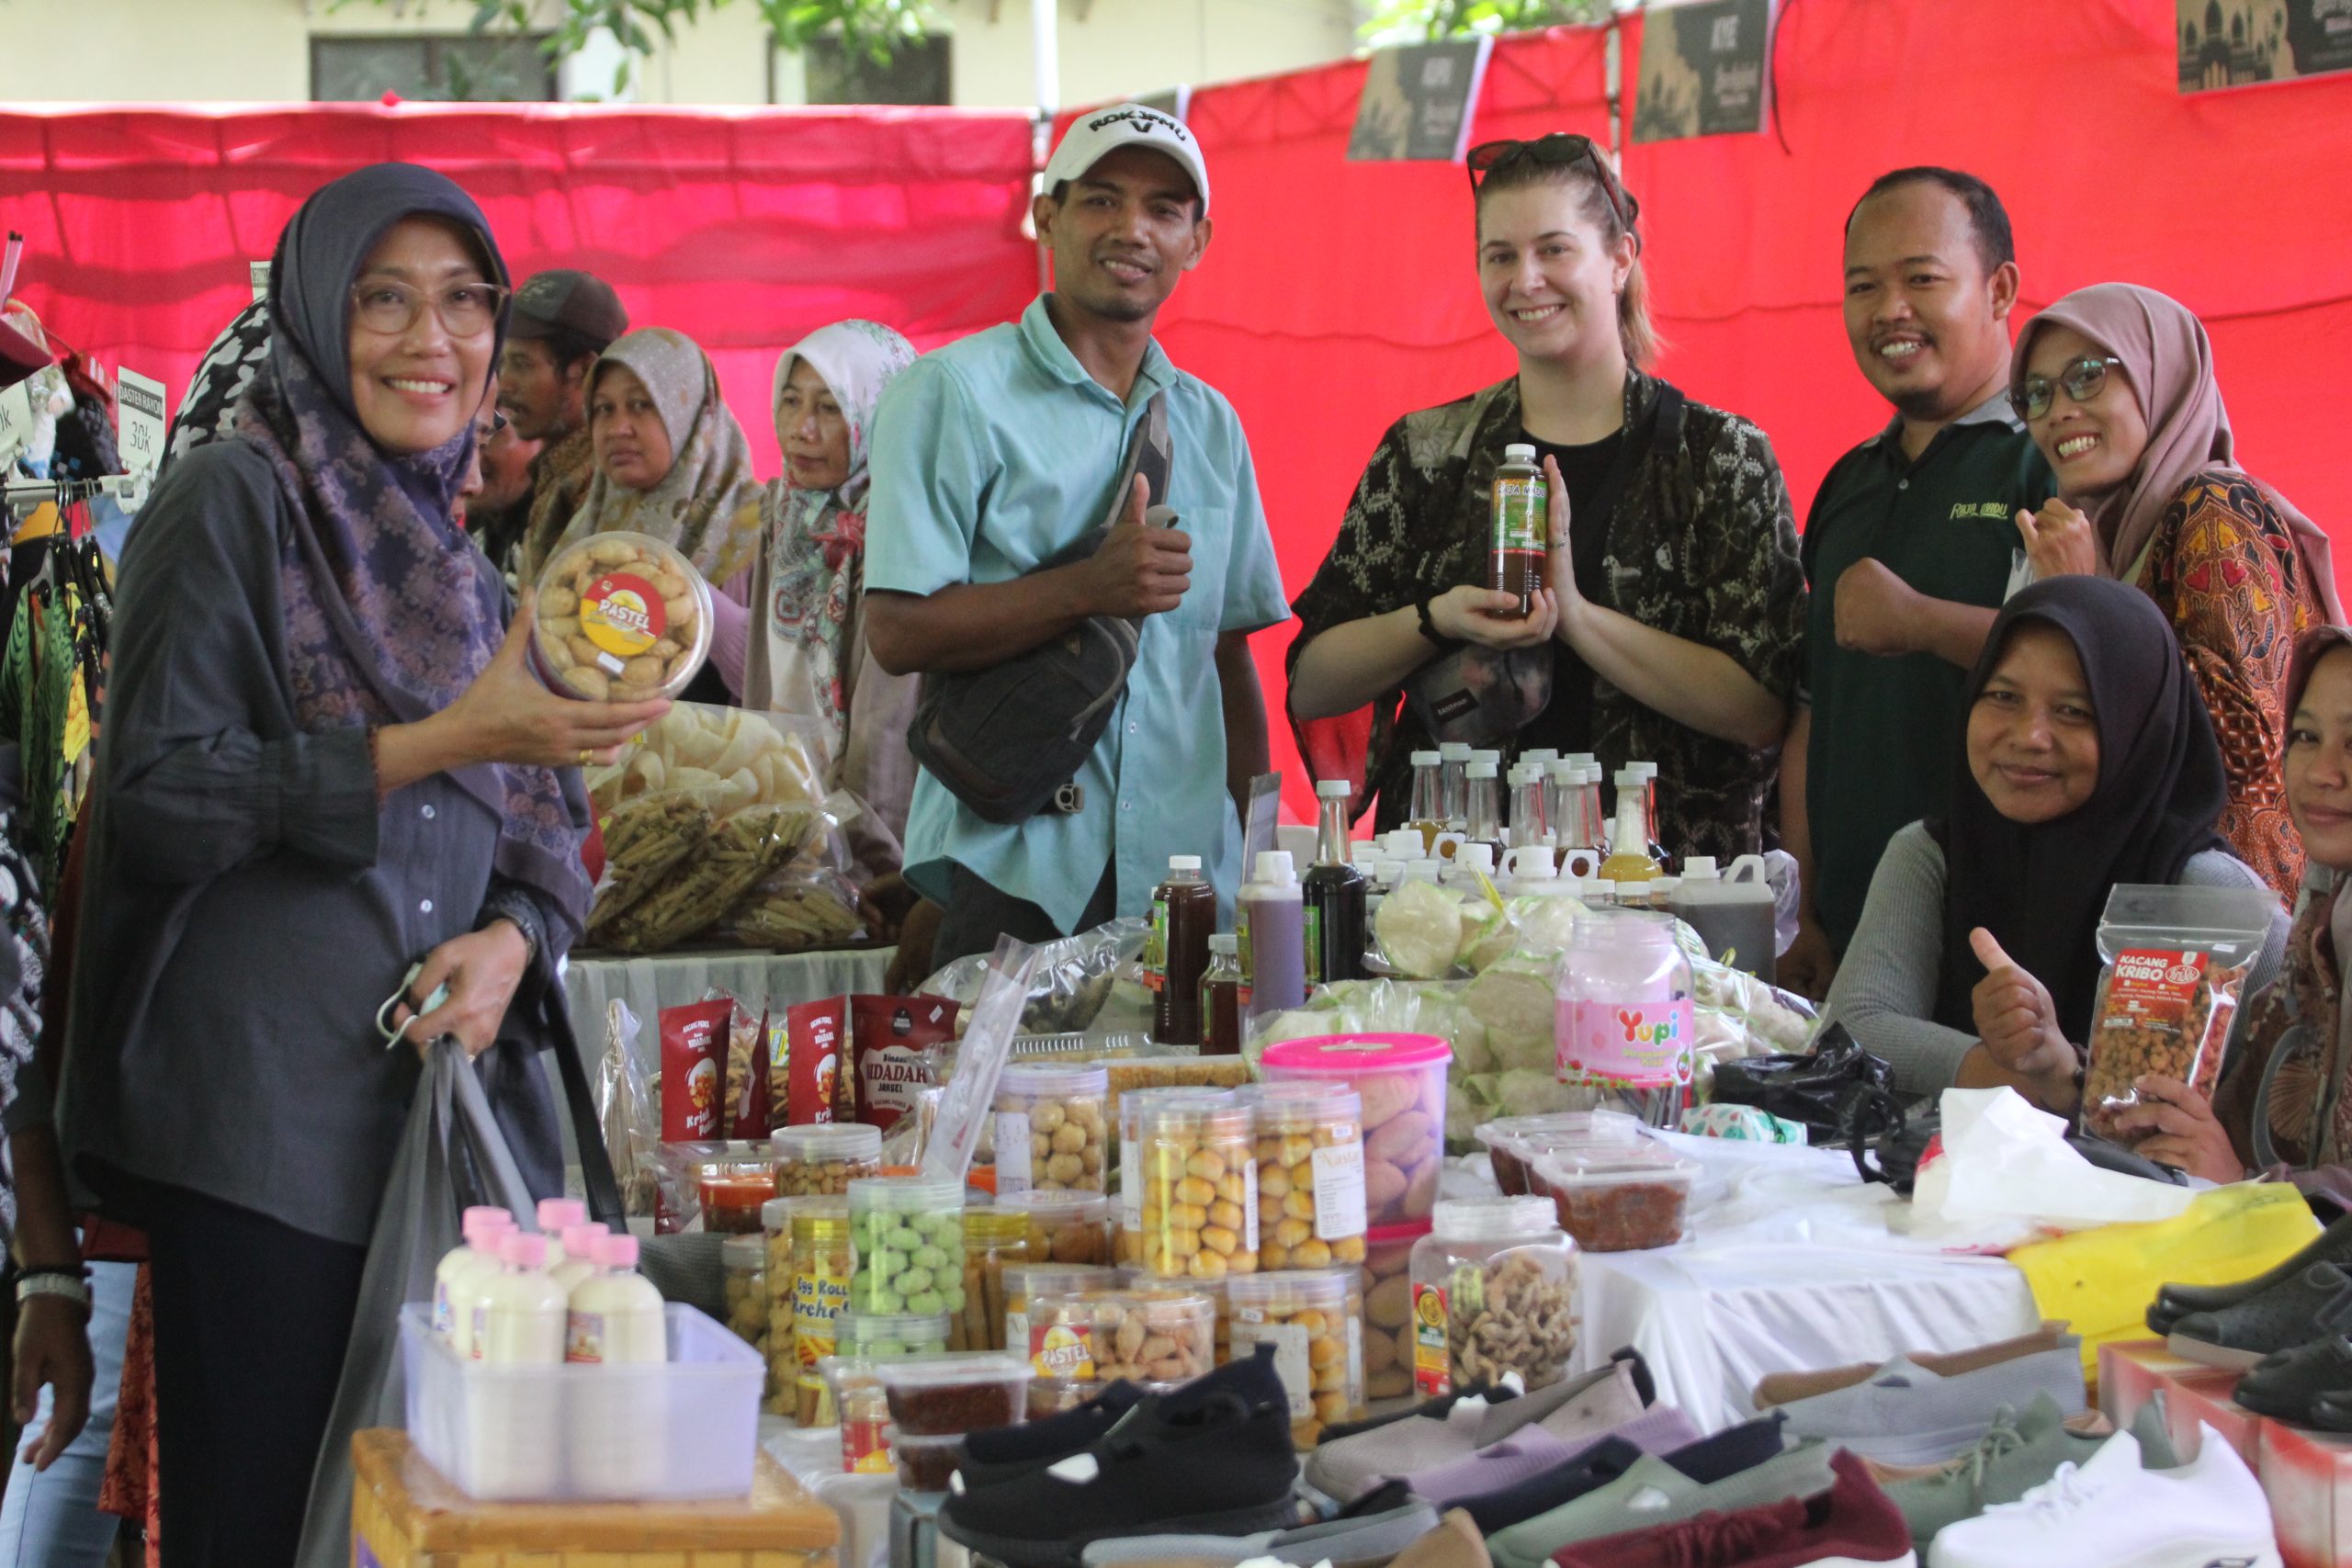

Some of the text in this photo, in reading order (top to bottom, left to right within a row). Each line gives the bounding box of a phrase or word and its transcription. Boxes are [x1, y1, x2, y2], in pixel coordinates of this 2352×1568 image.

[119, 385, 163, 416] DASTER RAYON
[1498, 484, 1545, 497] RAJA MADU
[598, 599, 650, 629] PASTEL
[1437, 698, 1468, 716] EASTPAK
[2120, 954, 2168, 967] KACANG
[2115, 965, 2164, 981] KRIBO
[1618, 1010, 1678, 1045] Yupi
[877, 1083, 903, 1093] JAKSEL
[797, 1276, 813, 1295] Egg
[1042, 1344, 1090, 1367] PASTEL
